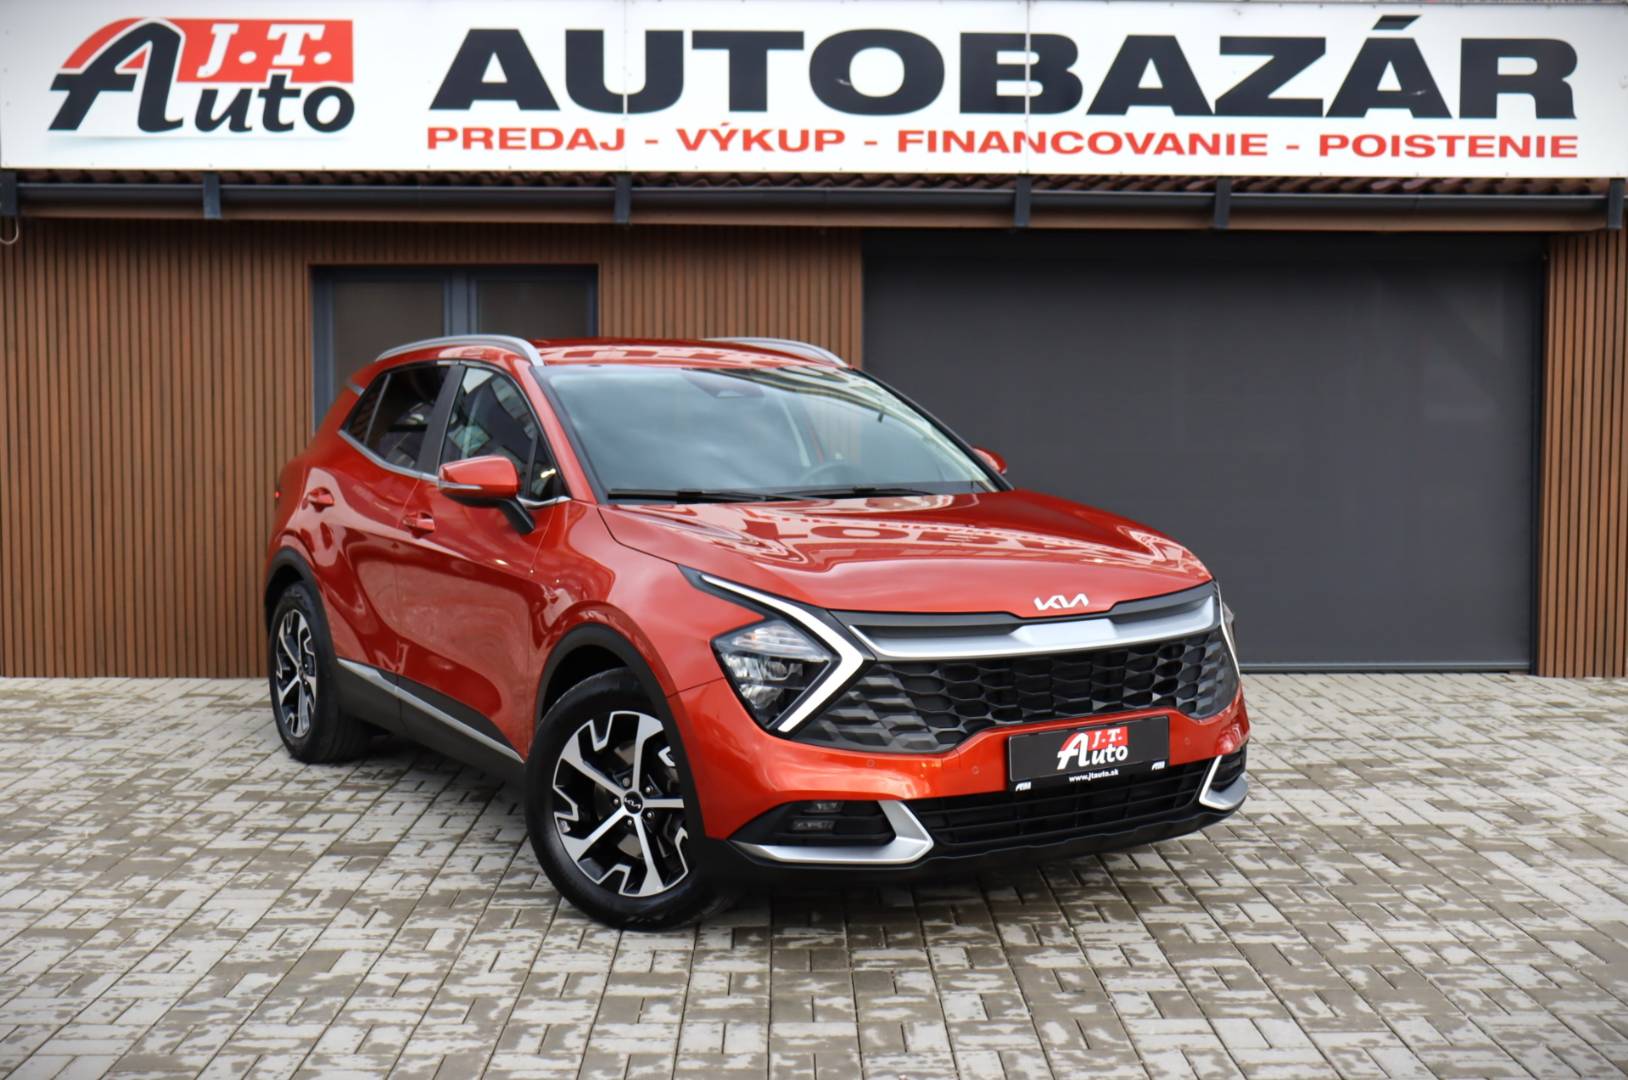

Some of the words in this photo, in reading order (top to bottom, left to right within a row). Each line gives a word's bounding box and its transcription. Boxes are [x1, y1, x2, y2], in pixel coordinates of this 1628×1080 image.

[197, 22, 333, 78] J.T.
[429, 15, 1578, 119] AUTOBAZÁR
[48, 21, 355, 133] Auto
[427, 127, 625, 152] PREDAJ
[677, 122, 846, 153] VÝKUP
[897, 129, 1268, 157] FINANCOVANIE
[1319, 133, 1577, 159] POISTENIE
[1033, 593, 1089, 611] KIA
[1057, 733, 1128, 769] Auto
[1068, 769, 1119, 782] www.jtauto.sk
